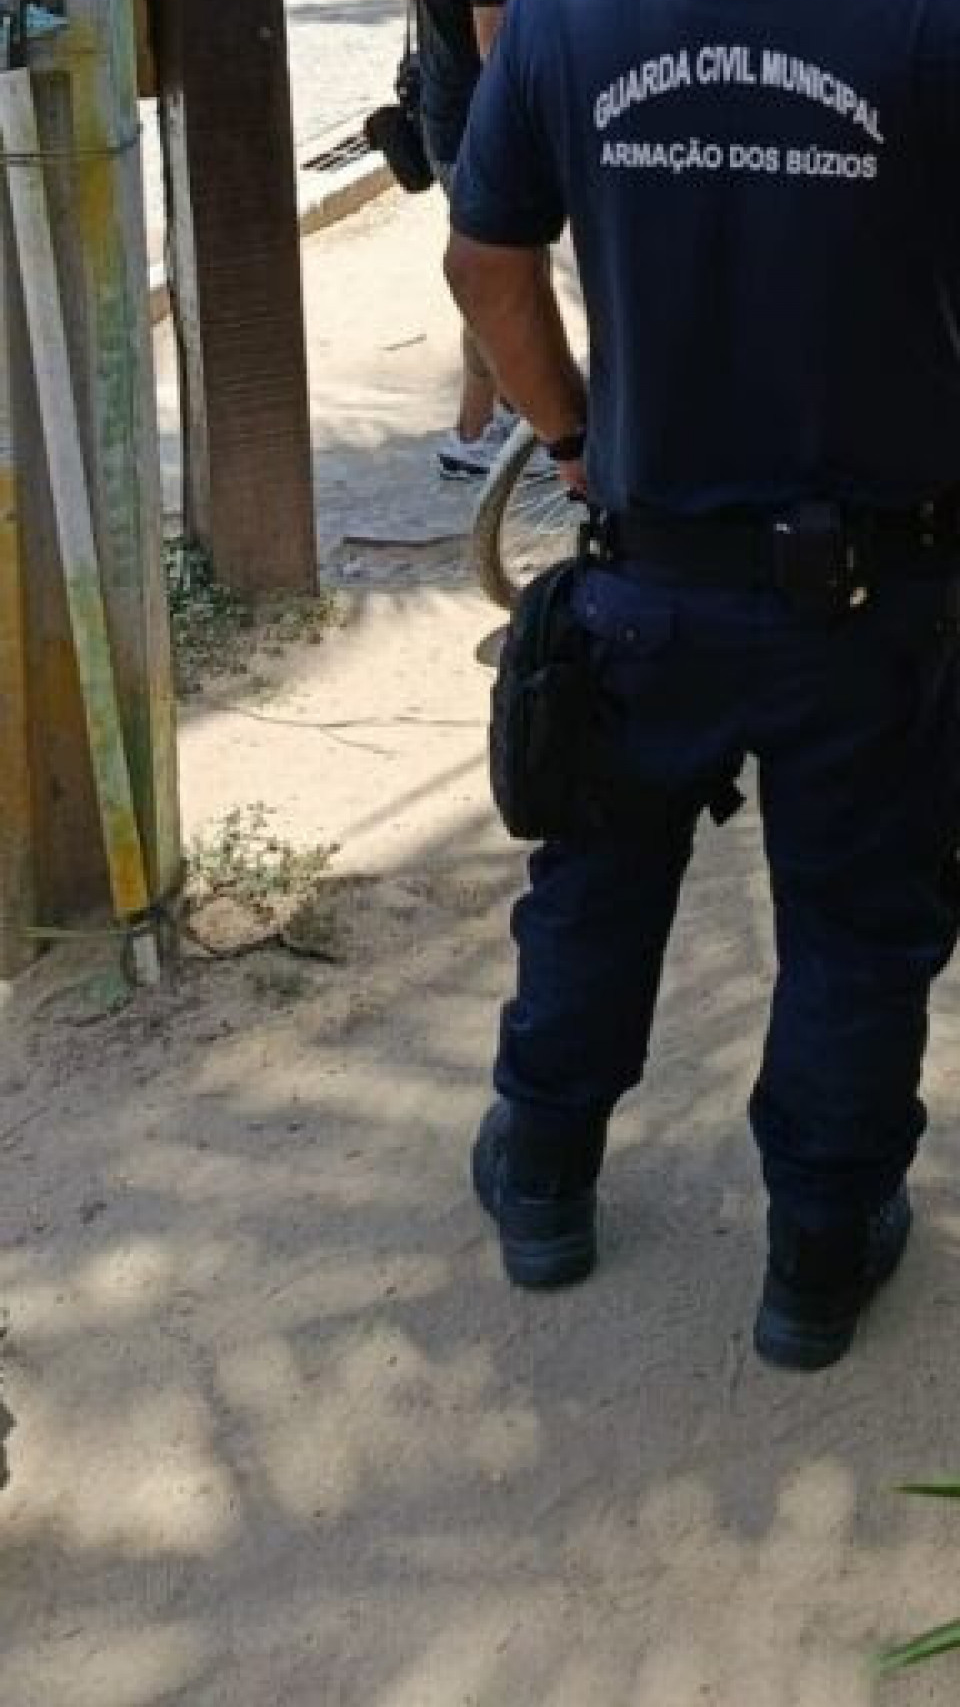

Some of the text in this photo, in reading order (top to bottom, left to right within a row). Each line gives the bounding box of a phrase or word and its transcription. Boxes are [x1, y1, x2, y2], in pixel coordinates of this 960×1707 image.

[593, 46, 885, 144] GUARDA CIVIL MUNICIPAL
[600, 137, 878, 178] ARMAÇÃO DOS BÚZIOS
